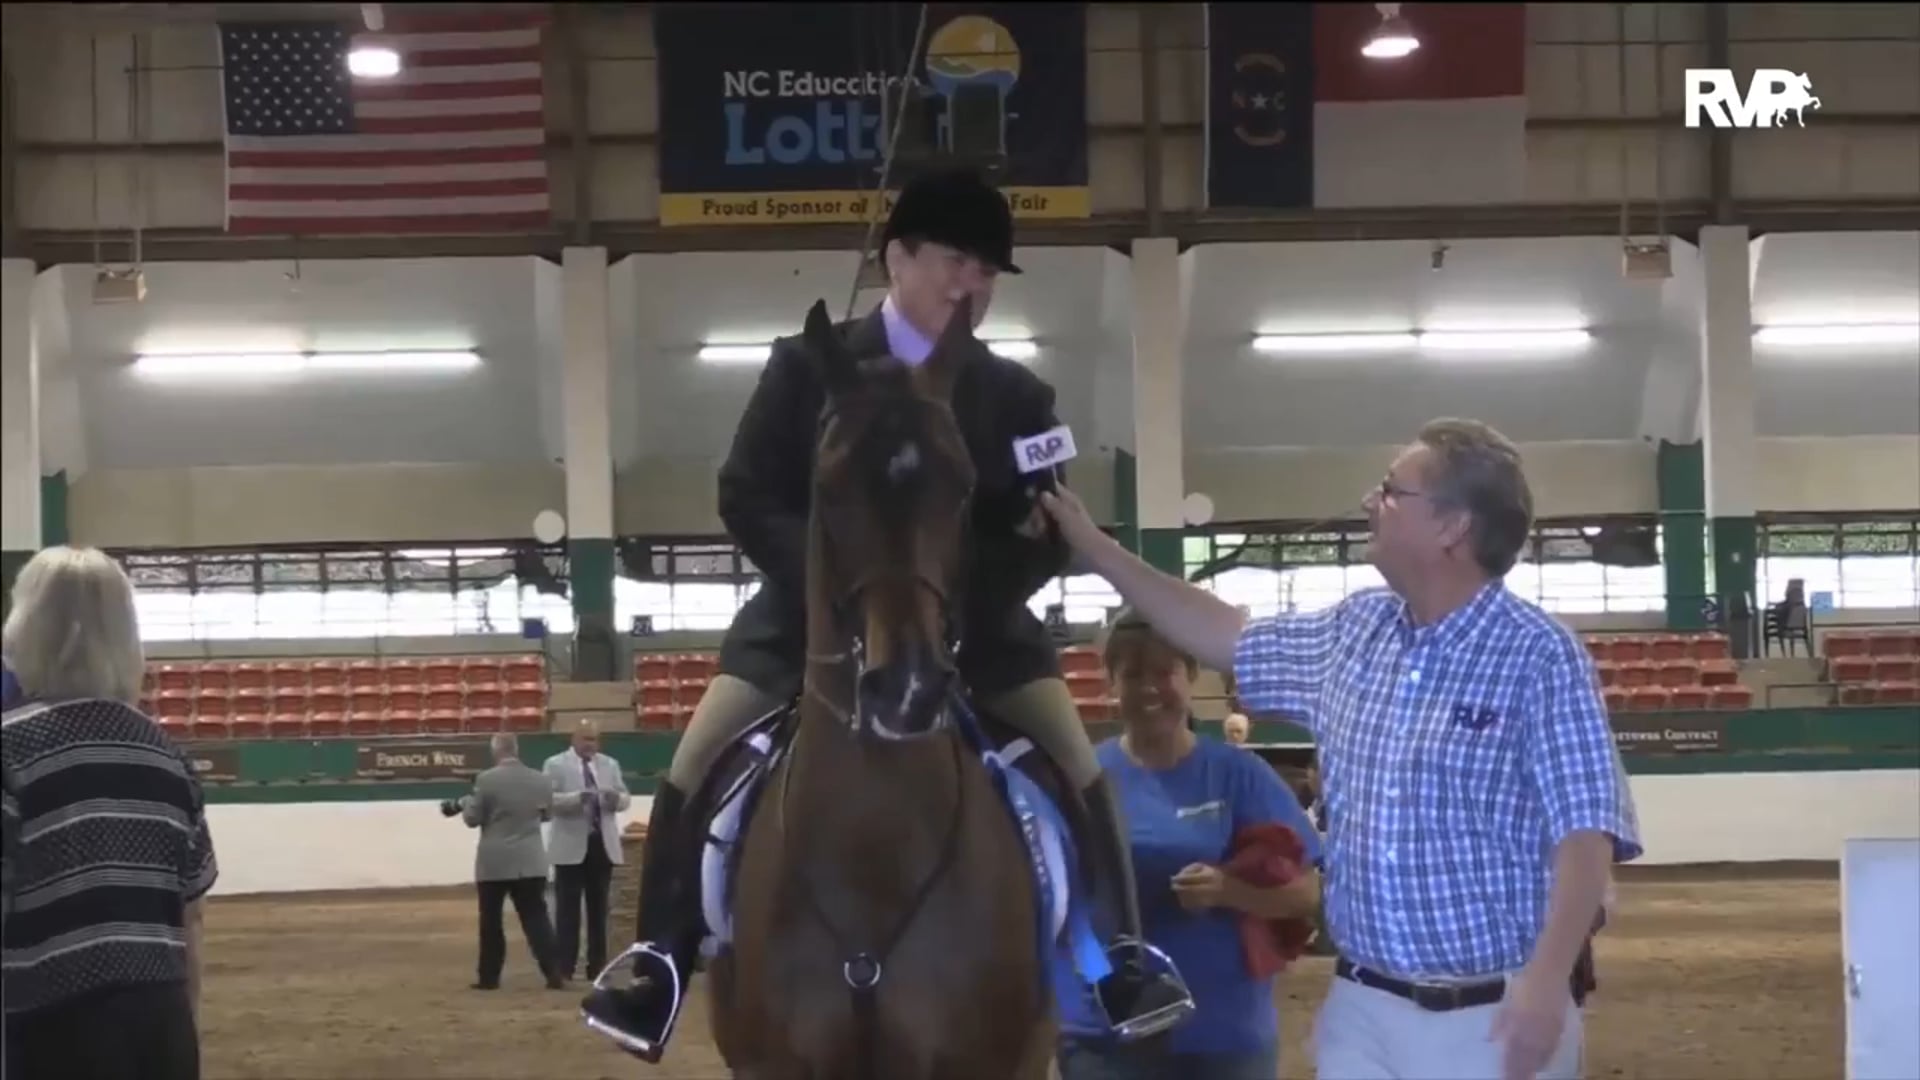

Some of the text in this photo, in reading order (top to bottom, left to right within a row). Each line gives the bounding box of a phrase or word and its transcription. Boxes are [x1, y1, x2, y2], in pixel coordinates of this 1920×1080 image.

[724, 72, 770, 97] NC
[702, 199, 758, 216] Proud
[765, 196, 842, 219] Sponsor
[848, 197, 869, 214] of
[1025, 436, 1063, 466] RVP
[376, 750, 466, 767] FRENCH WINE
